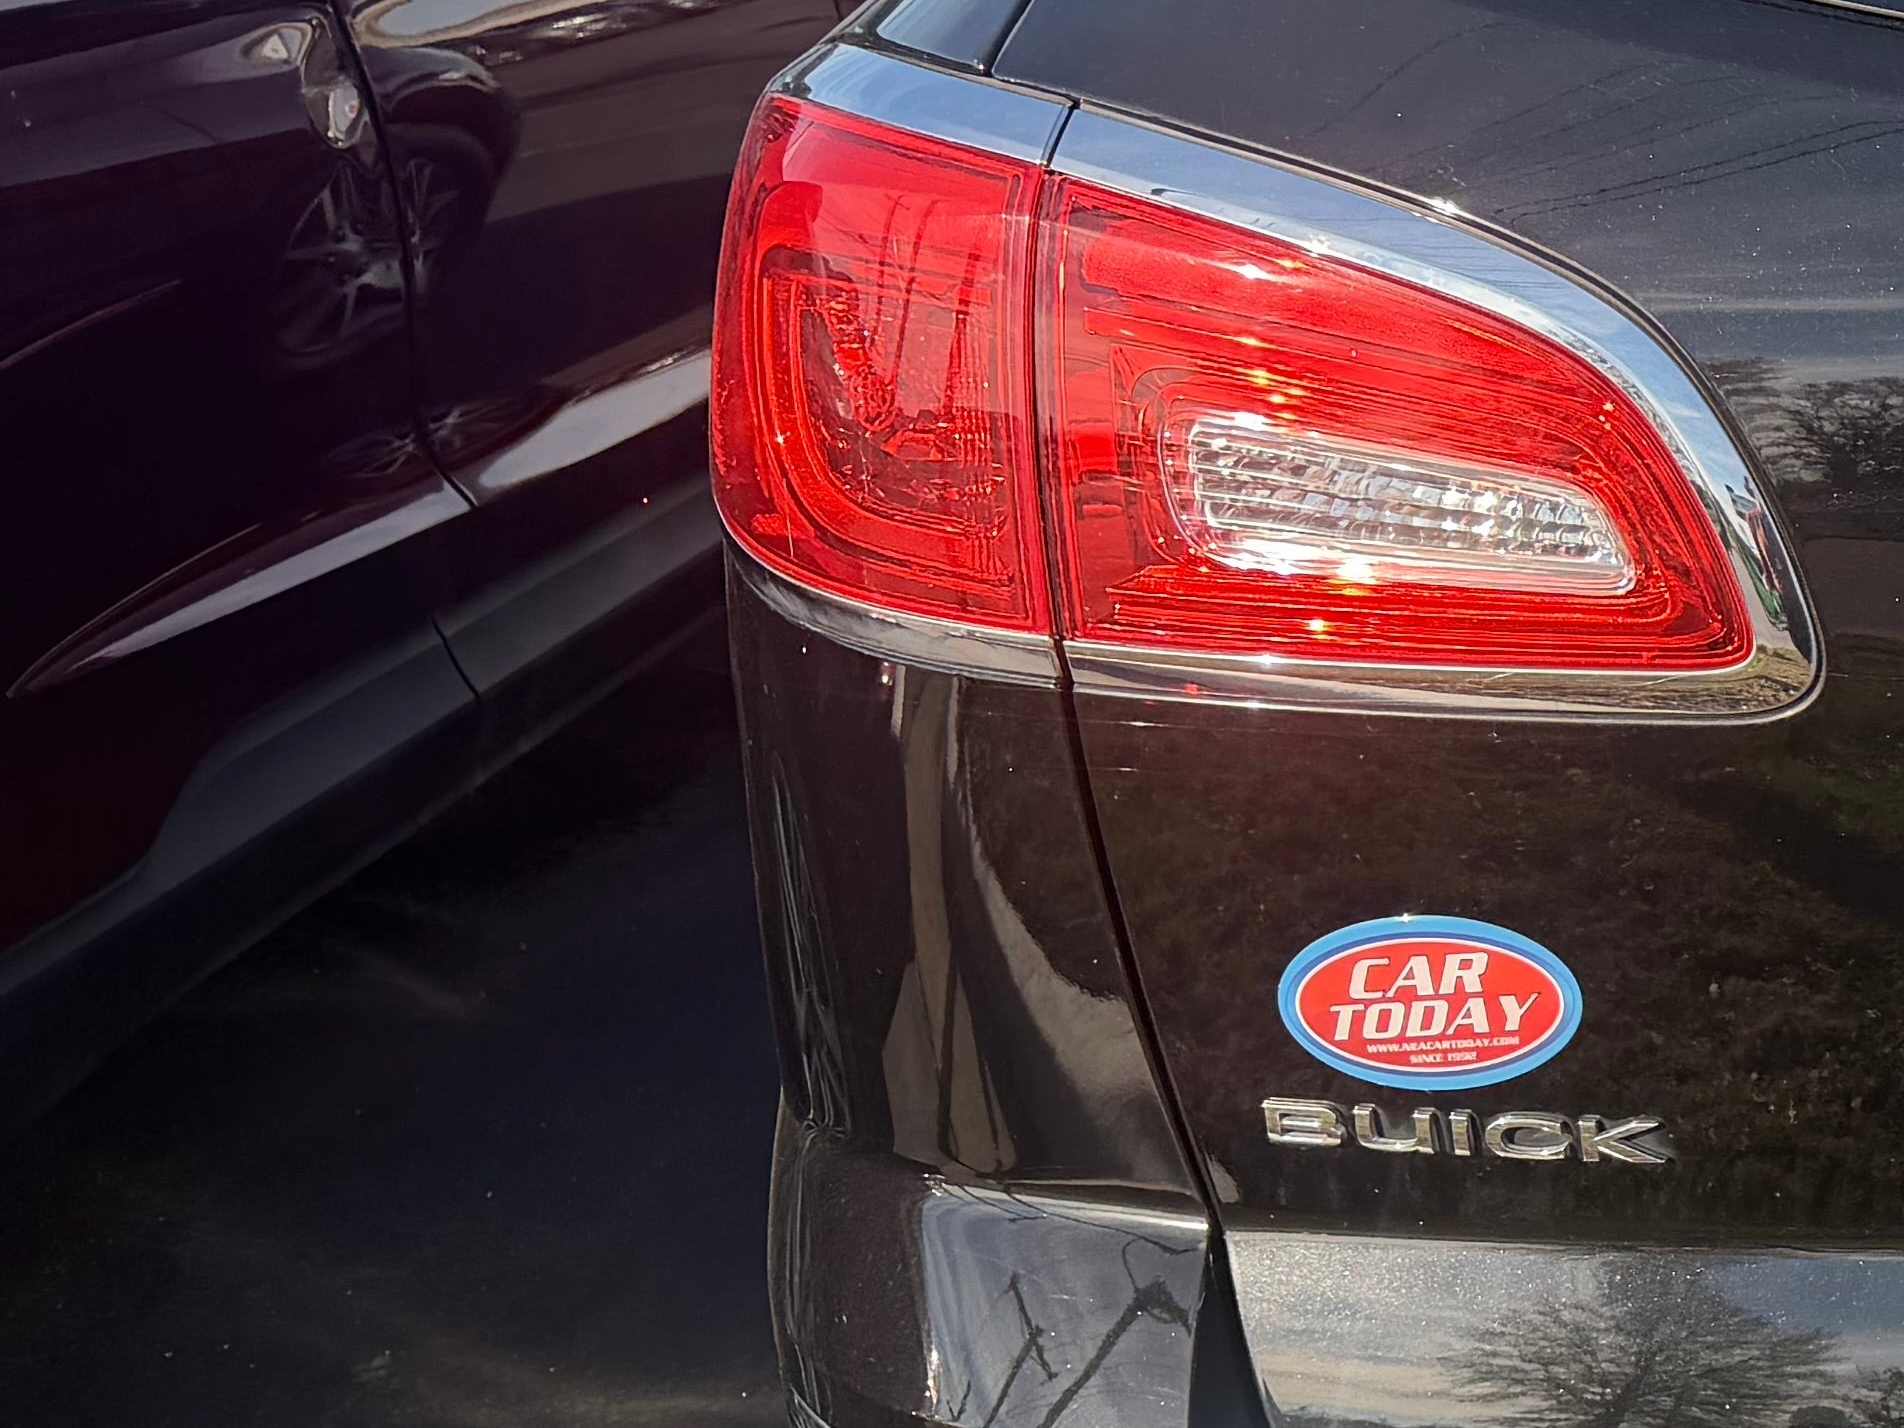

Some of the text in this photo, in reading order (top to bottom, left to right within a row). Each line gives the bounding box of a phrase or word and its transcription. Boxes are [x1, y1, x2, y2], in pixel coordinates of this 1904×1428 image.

[1348, 952, 1489, 1000] CAR
[1329, 992, 1539, 1041] TODAY
[1261, 1096, 1674, 1164] BUICK
